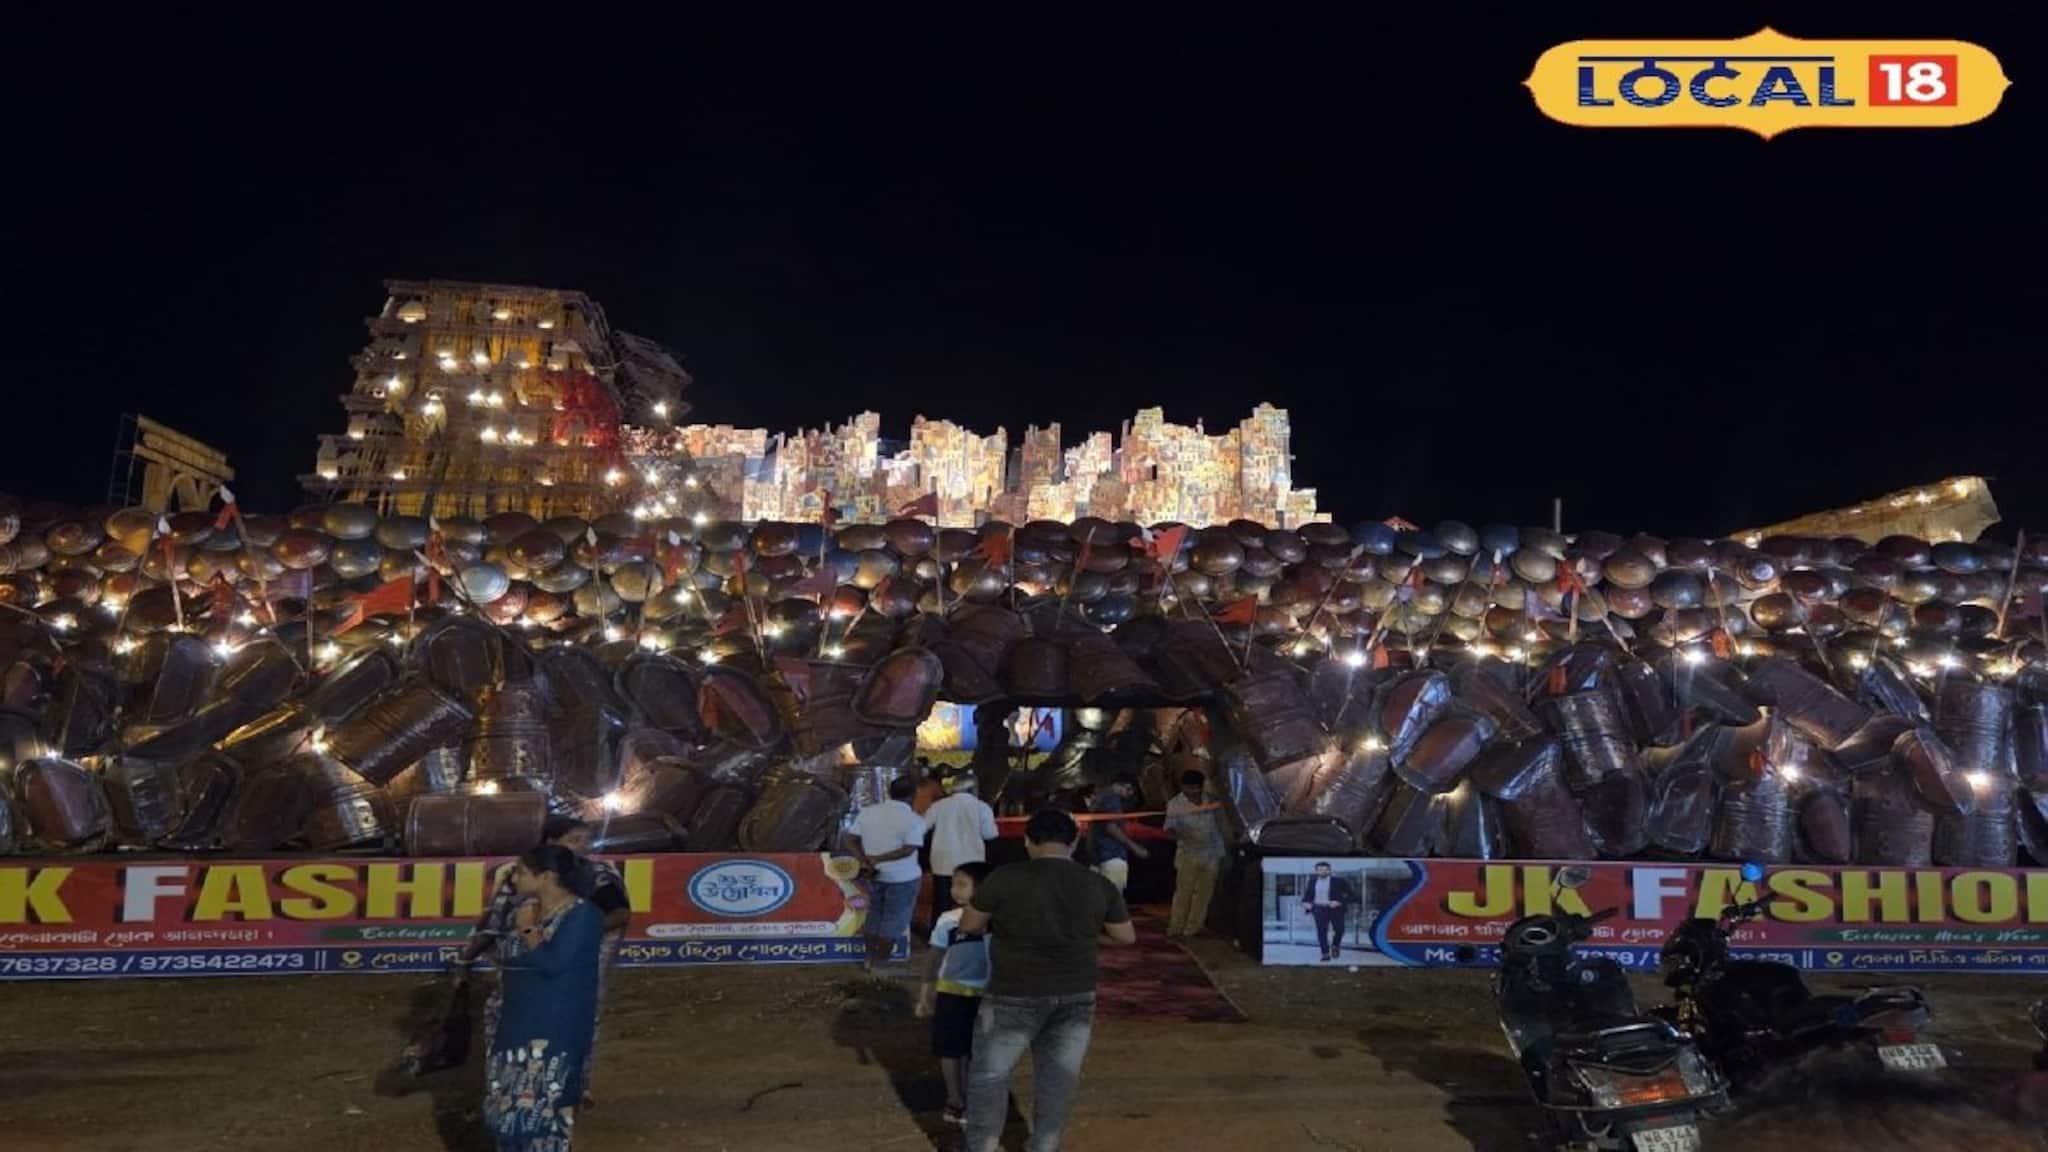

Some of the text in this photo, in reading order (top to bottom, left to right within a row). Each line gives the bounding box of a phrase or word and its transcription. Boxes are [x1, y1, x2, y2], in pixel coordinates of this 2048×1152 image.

[124, 861, 655, 924] FASHI
[1447, 864, 1592, 918] JK
[139, 952, 304, 971] 9735422473
